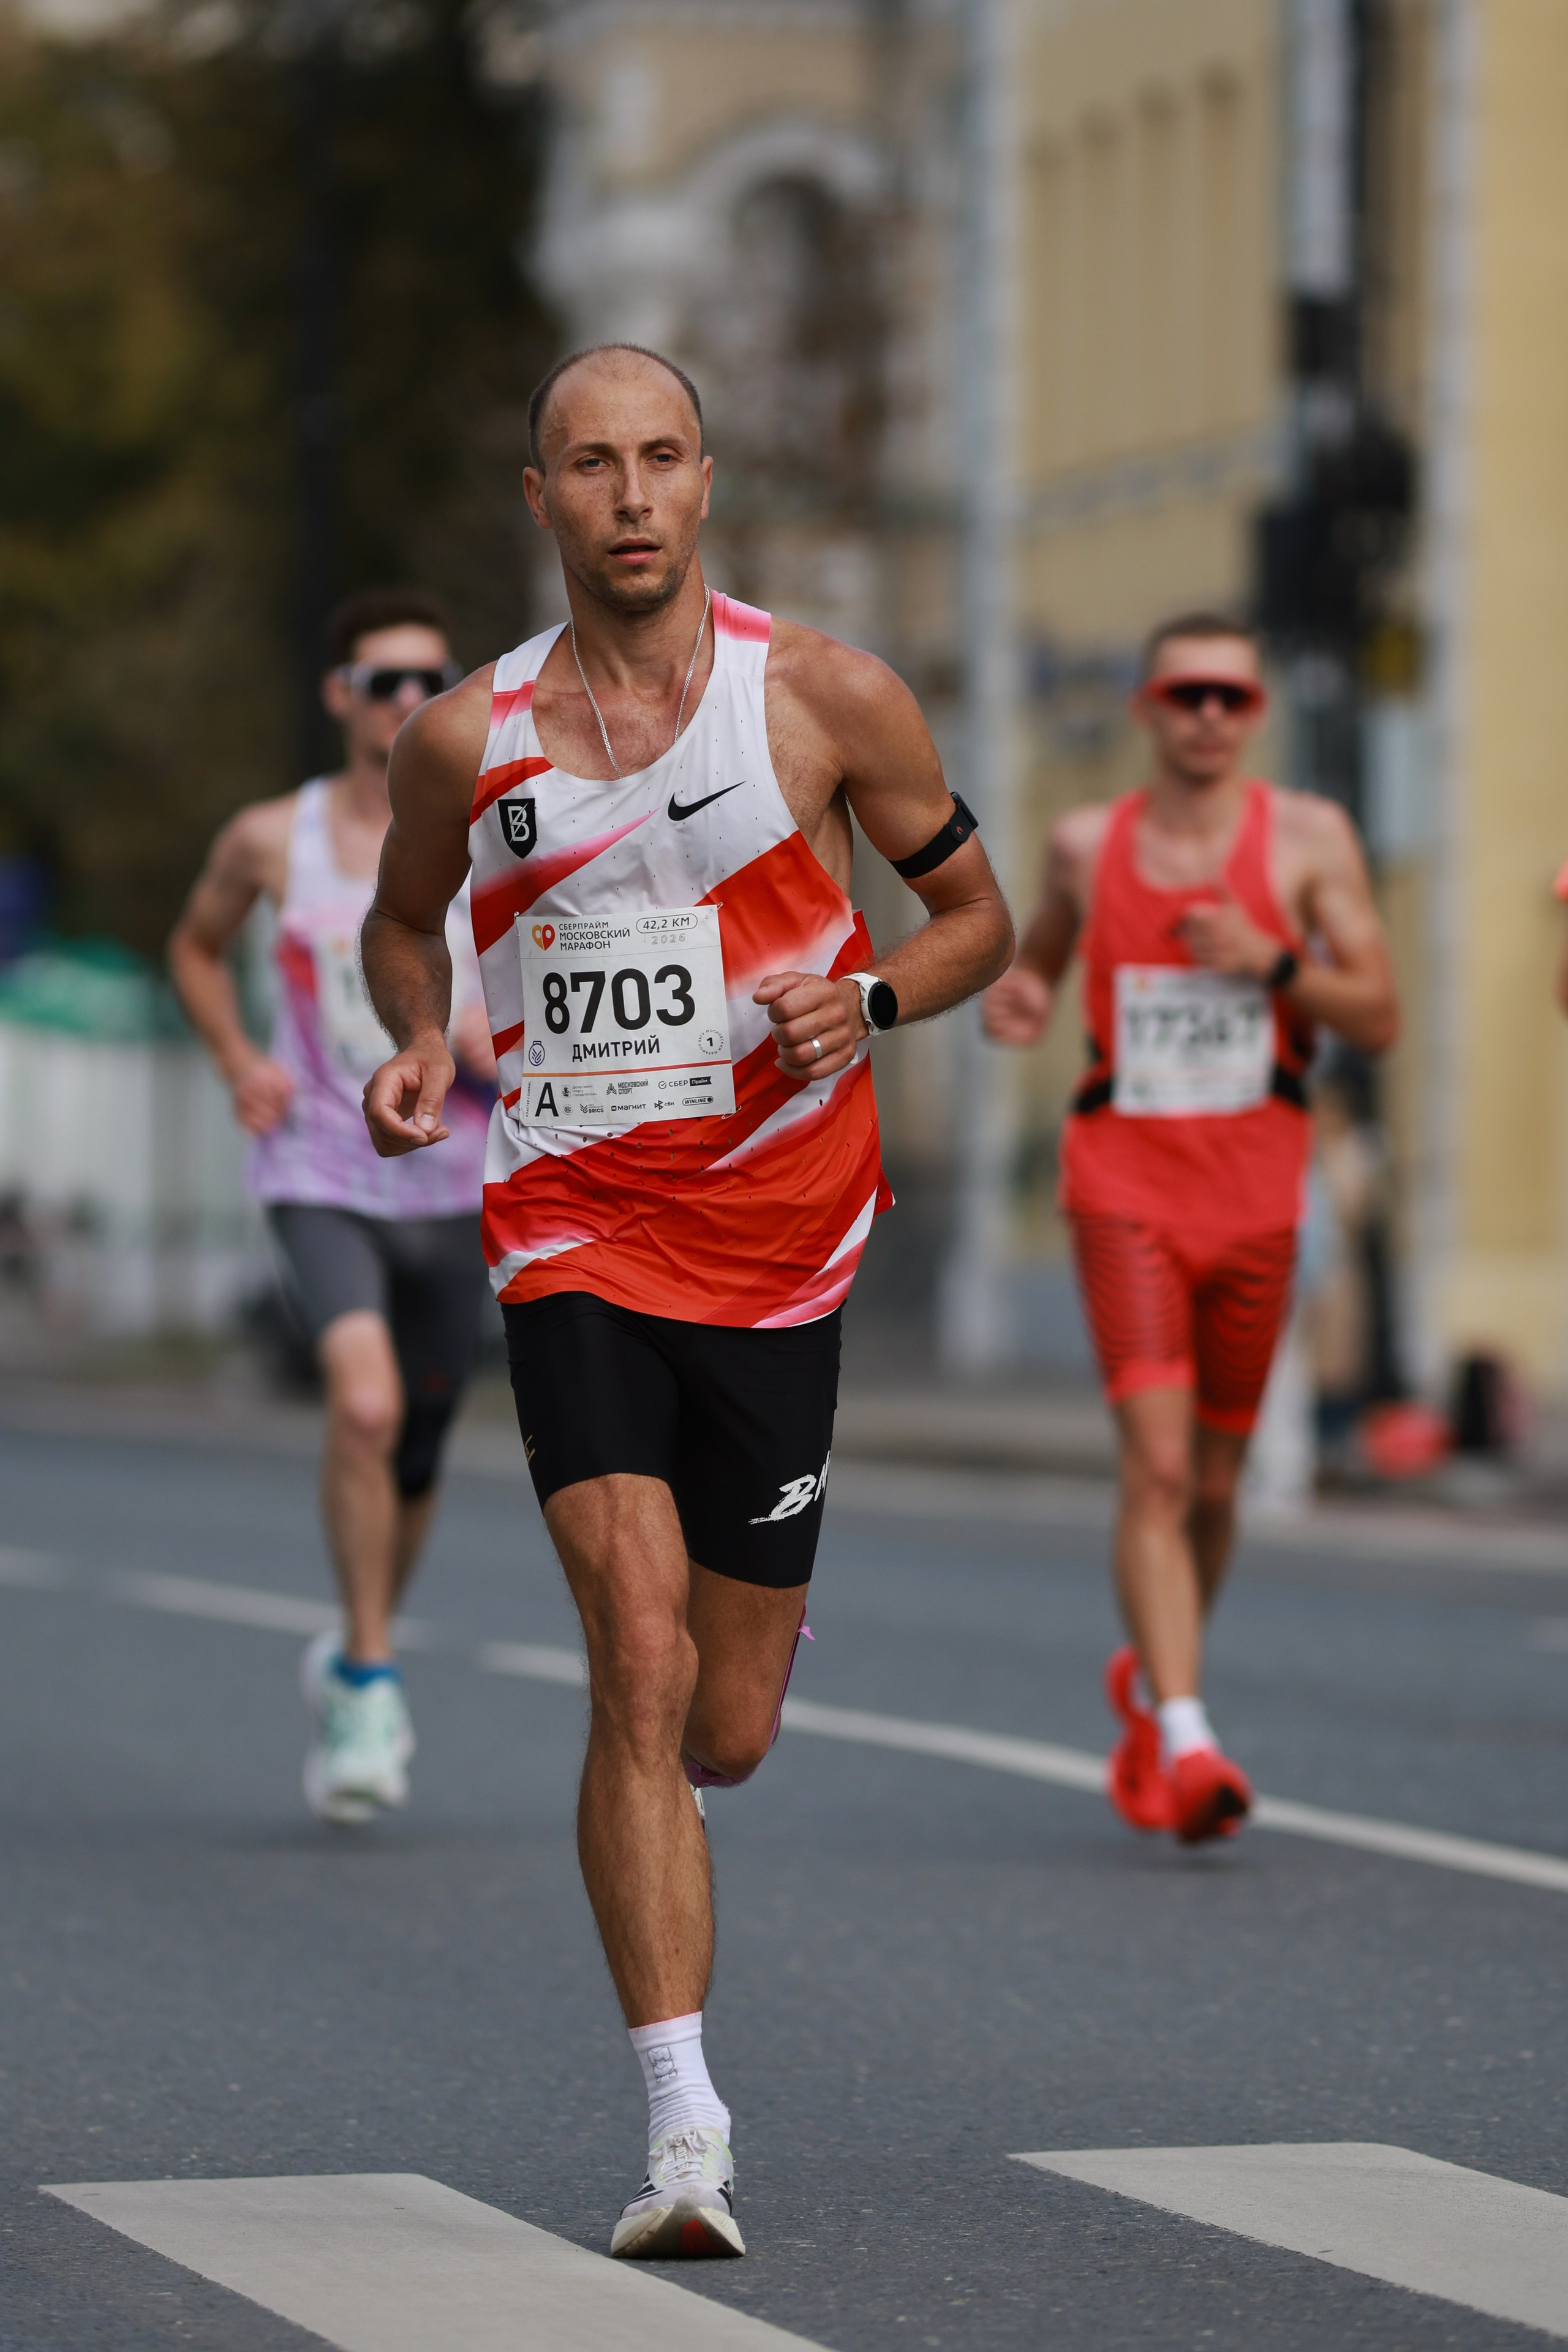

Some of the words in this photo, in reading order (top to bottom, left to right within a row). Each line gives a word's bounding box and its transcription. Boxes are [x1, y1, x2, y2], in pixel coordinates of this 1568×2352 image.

[559, 921, 609, 931] СБЕРПРАЙМ
[643, 919, 667, 930] 42,2
[672, 917, 690, 927] КМ
[559, 927, 630, 941] МОСКОВСКИЙ
[652, 933, 685, 945] 2026
[560, 941, 611, 951] МАРАФОН
[543, 964, 695, 1035] 8703
[706, 1037, 714, 1047] 1
[571, 1035, 660, 1063] ДМИТРИЙ
[617, 1079, 649, 1088] МОСКОВСКИЙ
